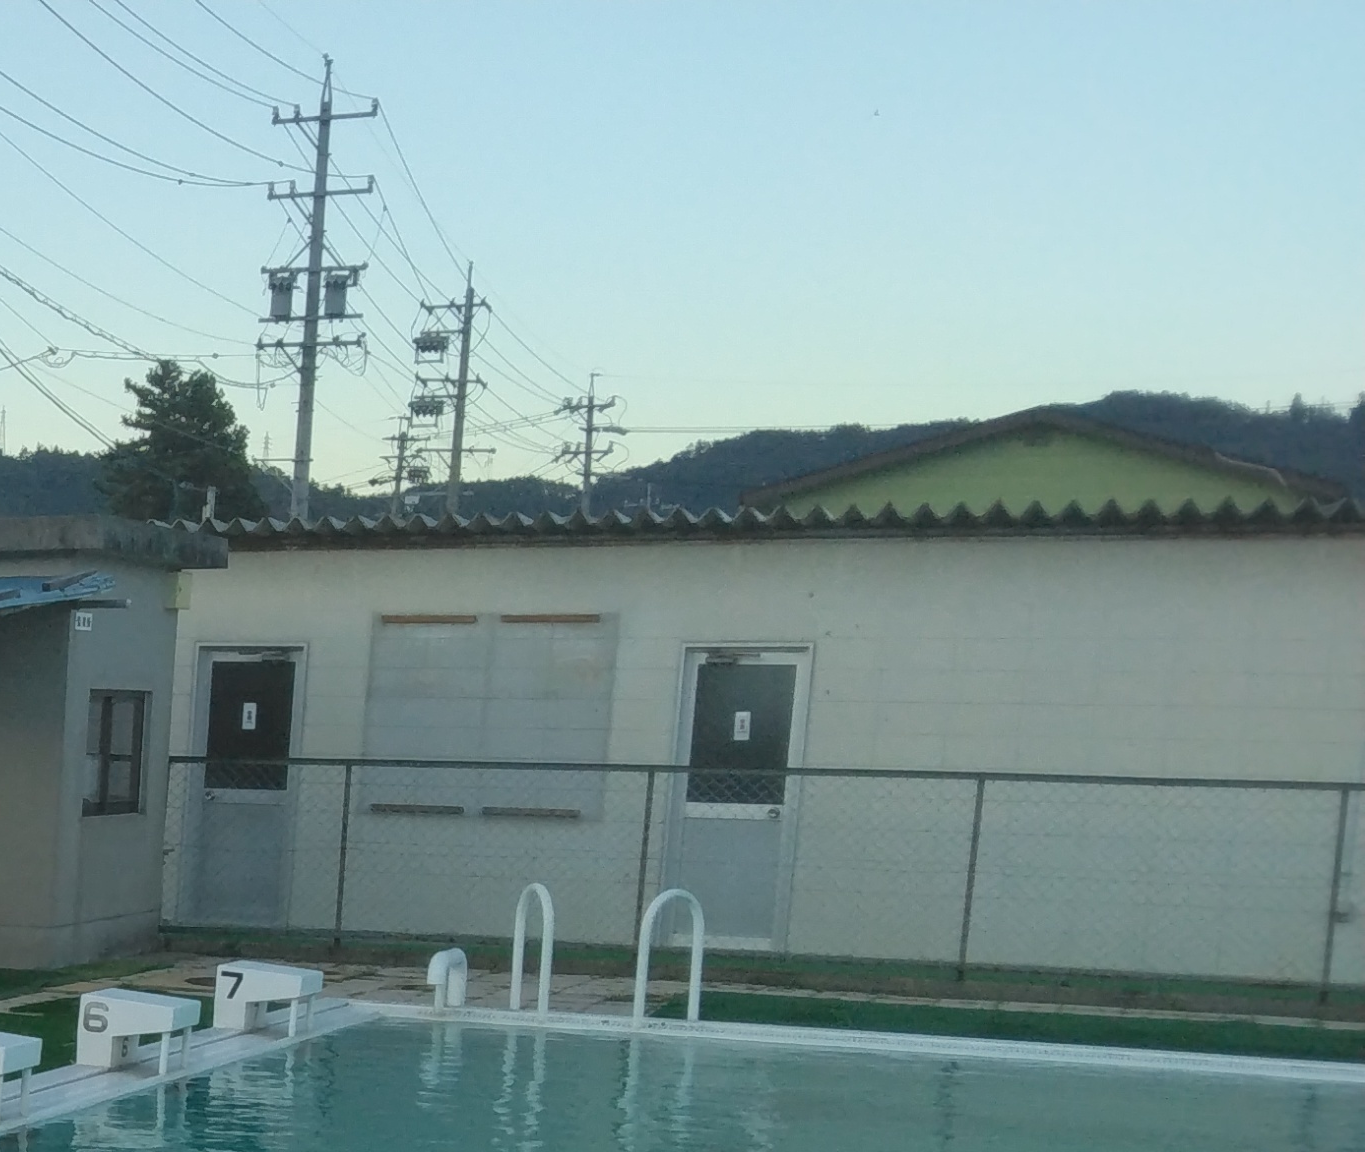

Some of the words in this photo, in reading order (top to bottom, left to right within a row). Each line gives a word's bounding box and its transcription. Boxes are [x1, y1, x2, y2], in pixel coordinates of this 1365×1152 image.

[221, 971, 243, 999] 7
[83, 1002, 109, 1033] 6
[121, 1035, 129, 1058] 6
